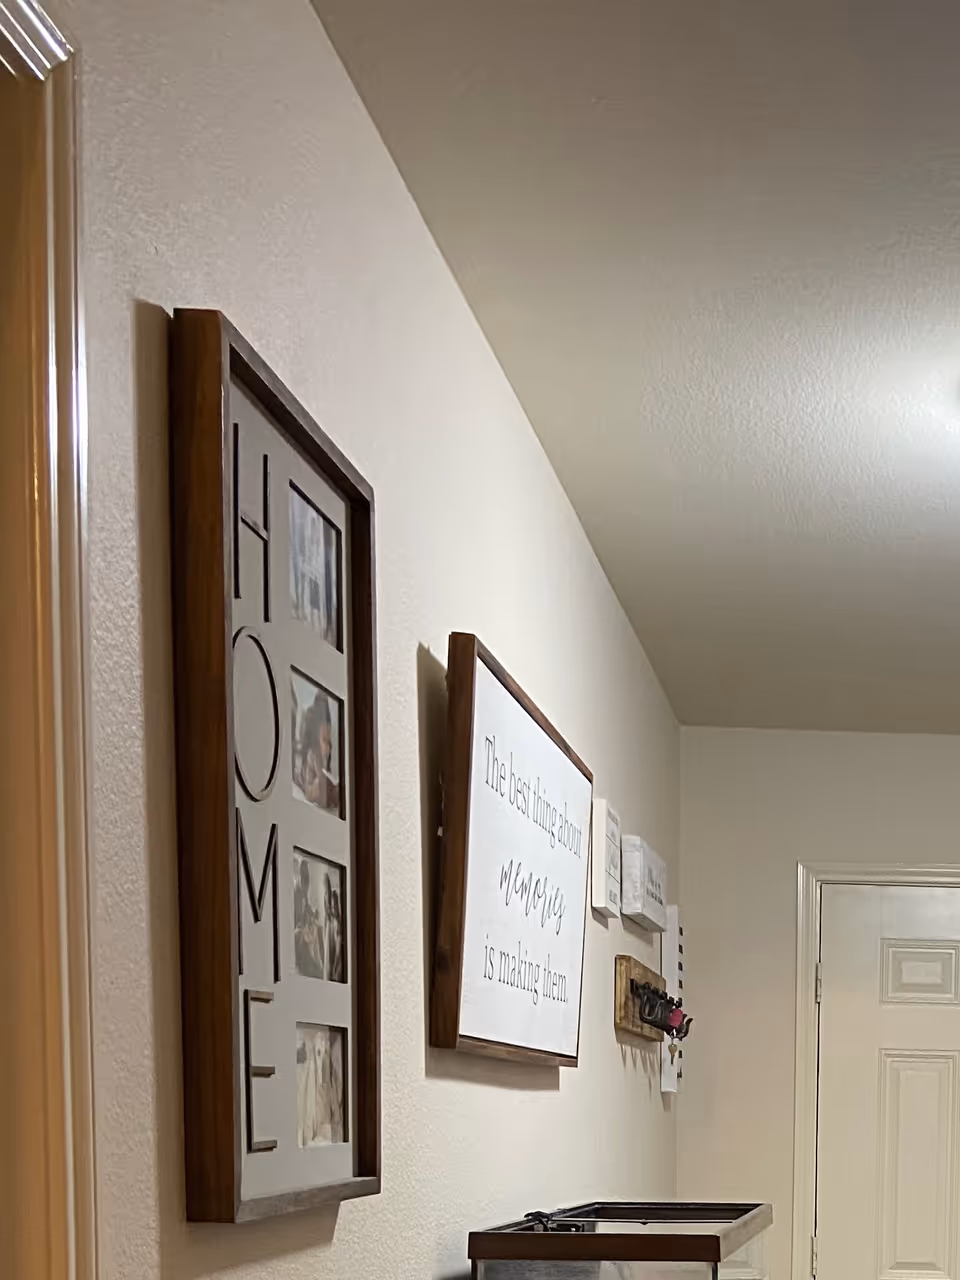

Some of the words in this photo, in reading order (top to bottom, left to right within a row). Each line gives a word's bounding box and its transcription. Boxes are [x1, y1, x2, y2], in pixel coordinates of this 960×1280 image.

[231, 422, 281, 1154] HOME
[485, 734, 506, 798] The
[509, 751, 531, 819] best
[533, 776, 557, 849] thing
[558, 801, 582, 859] about
[499, 858, 566, 936] memories
[483, 933, 495, 981] is
[498, 940, 541, 1006] making
